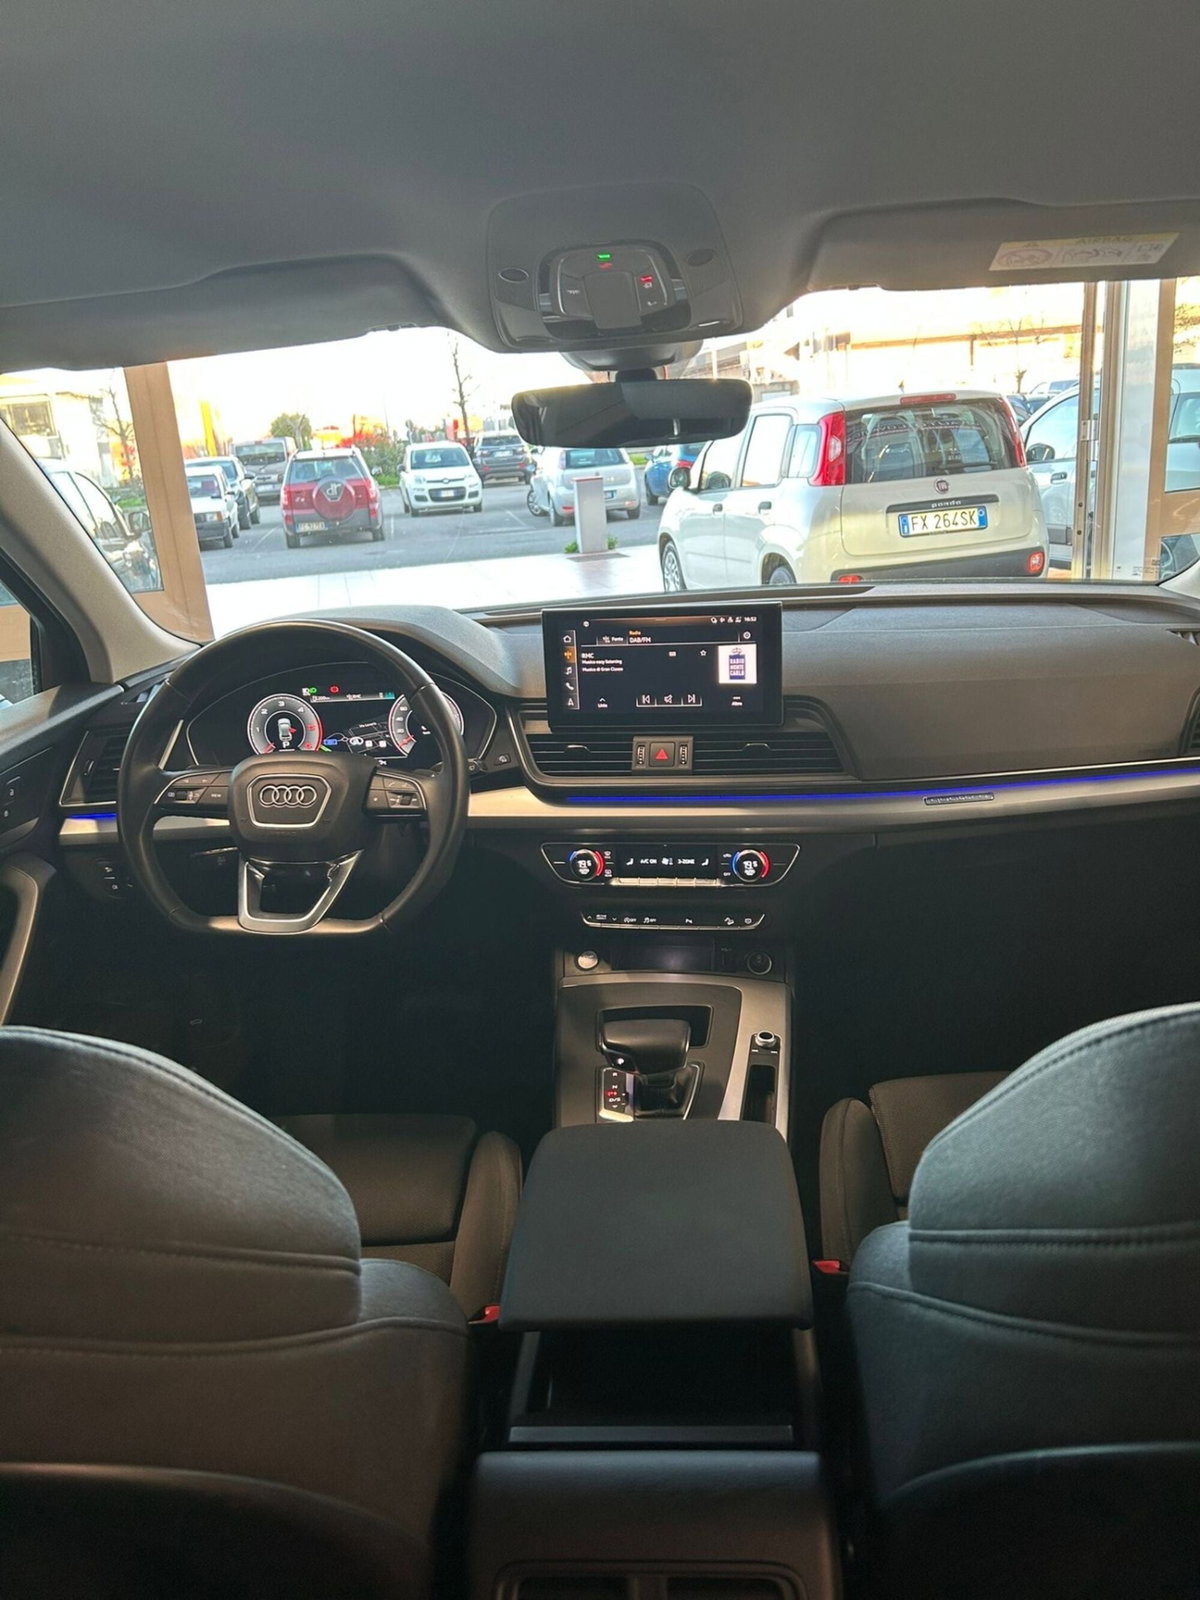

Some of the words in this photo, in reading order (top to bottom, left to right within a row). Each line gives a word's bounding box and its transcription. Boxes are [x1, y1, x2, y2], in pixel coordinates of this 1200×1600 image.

[931, 500, 962, 508] panda
[911, 515, 928, 531] FX
[934, 510, 977, 529] 264SK
